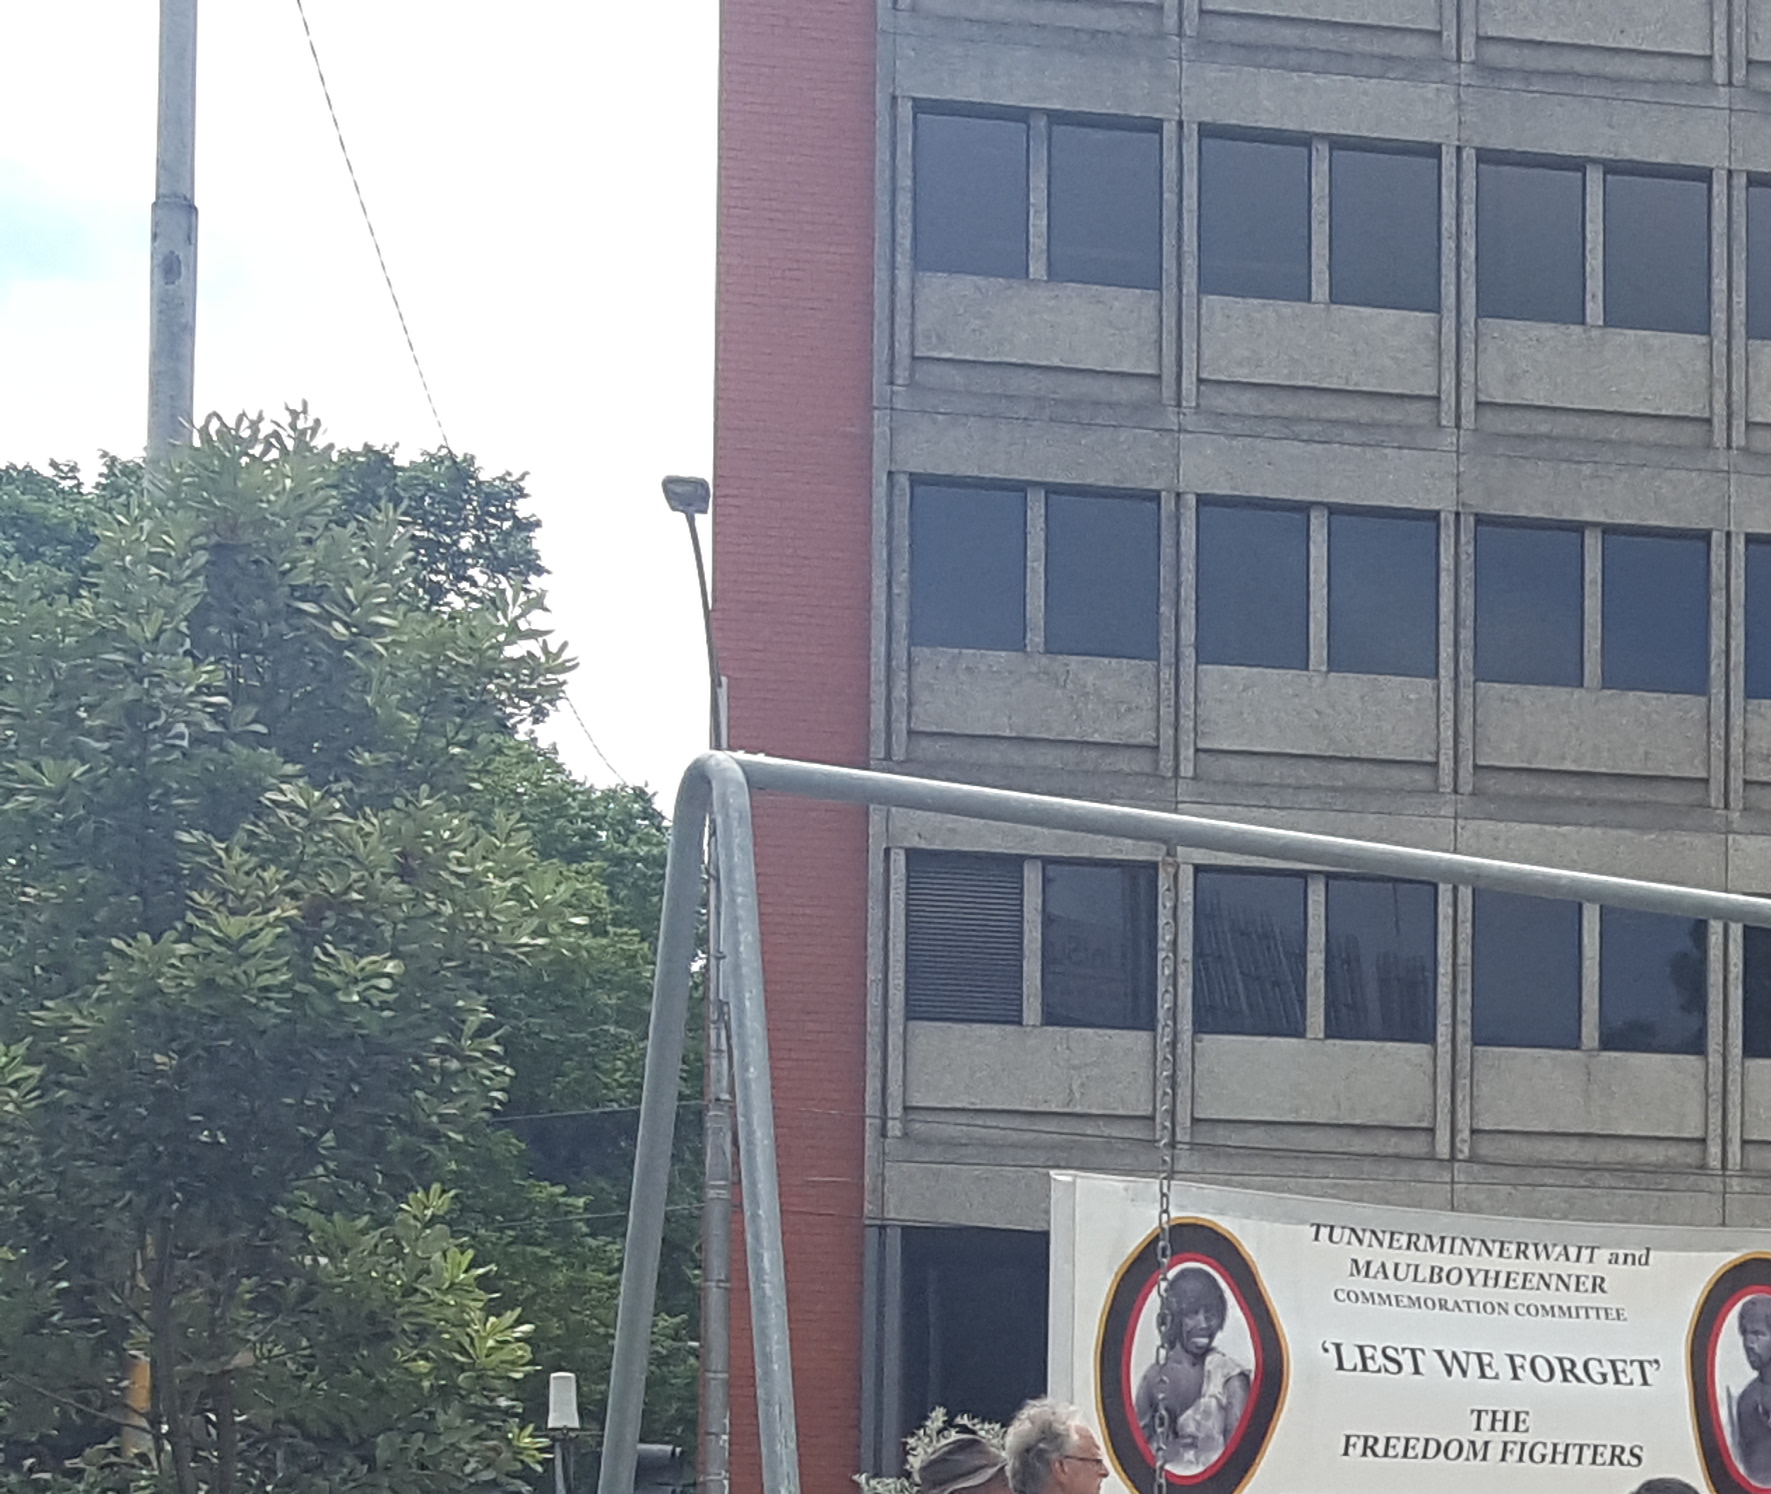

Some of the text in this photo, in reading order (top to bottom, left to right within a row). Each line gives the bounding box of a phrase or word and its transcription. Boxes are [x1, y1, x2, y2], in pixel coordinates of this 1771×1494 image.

[1310, 1222, 1652, 1267] TUNNERMINNERWAIT and
[1348, 1258, 1608, 1294] MAULBOYHEENNER
[1333, 1288, 1628, 1322] COMMEMORATION COMMITTEE
[1433, 1349, 1500, 1381] WE
[1470, 1408, 1530, 1433] THE
[1340, 1434, 1645, 1468] FREEDOM FIGHTERS
